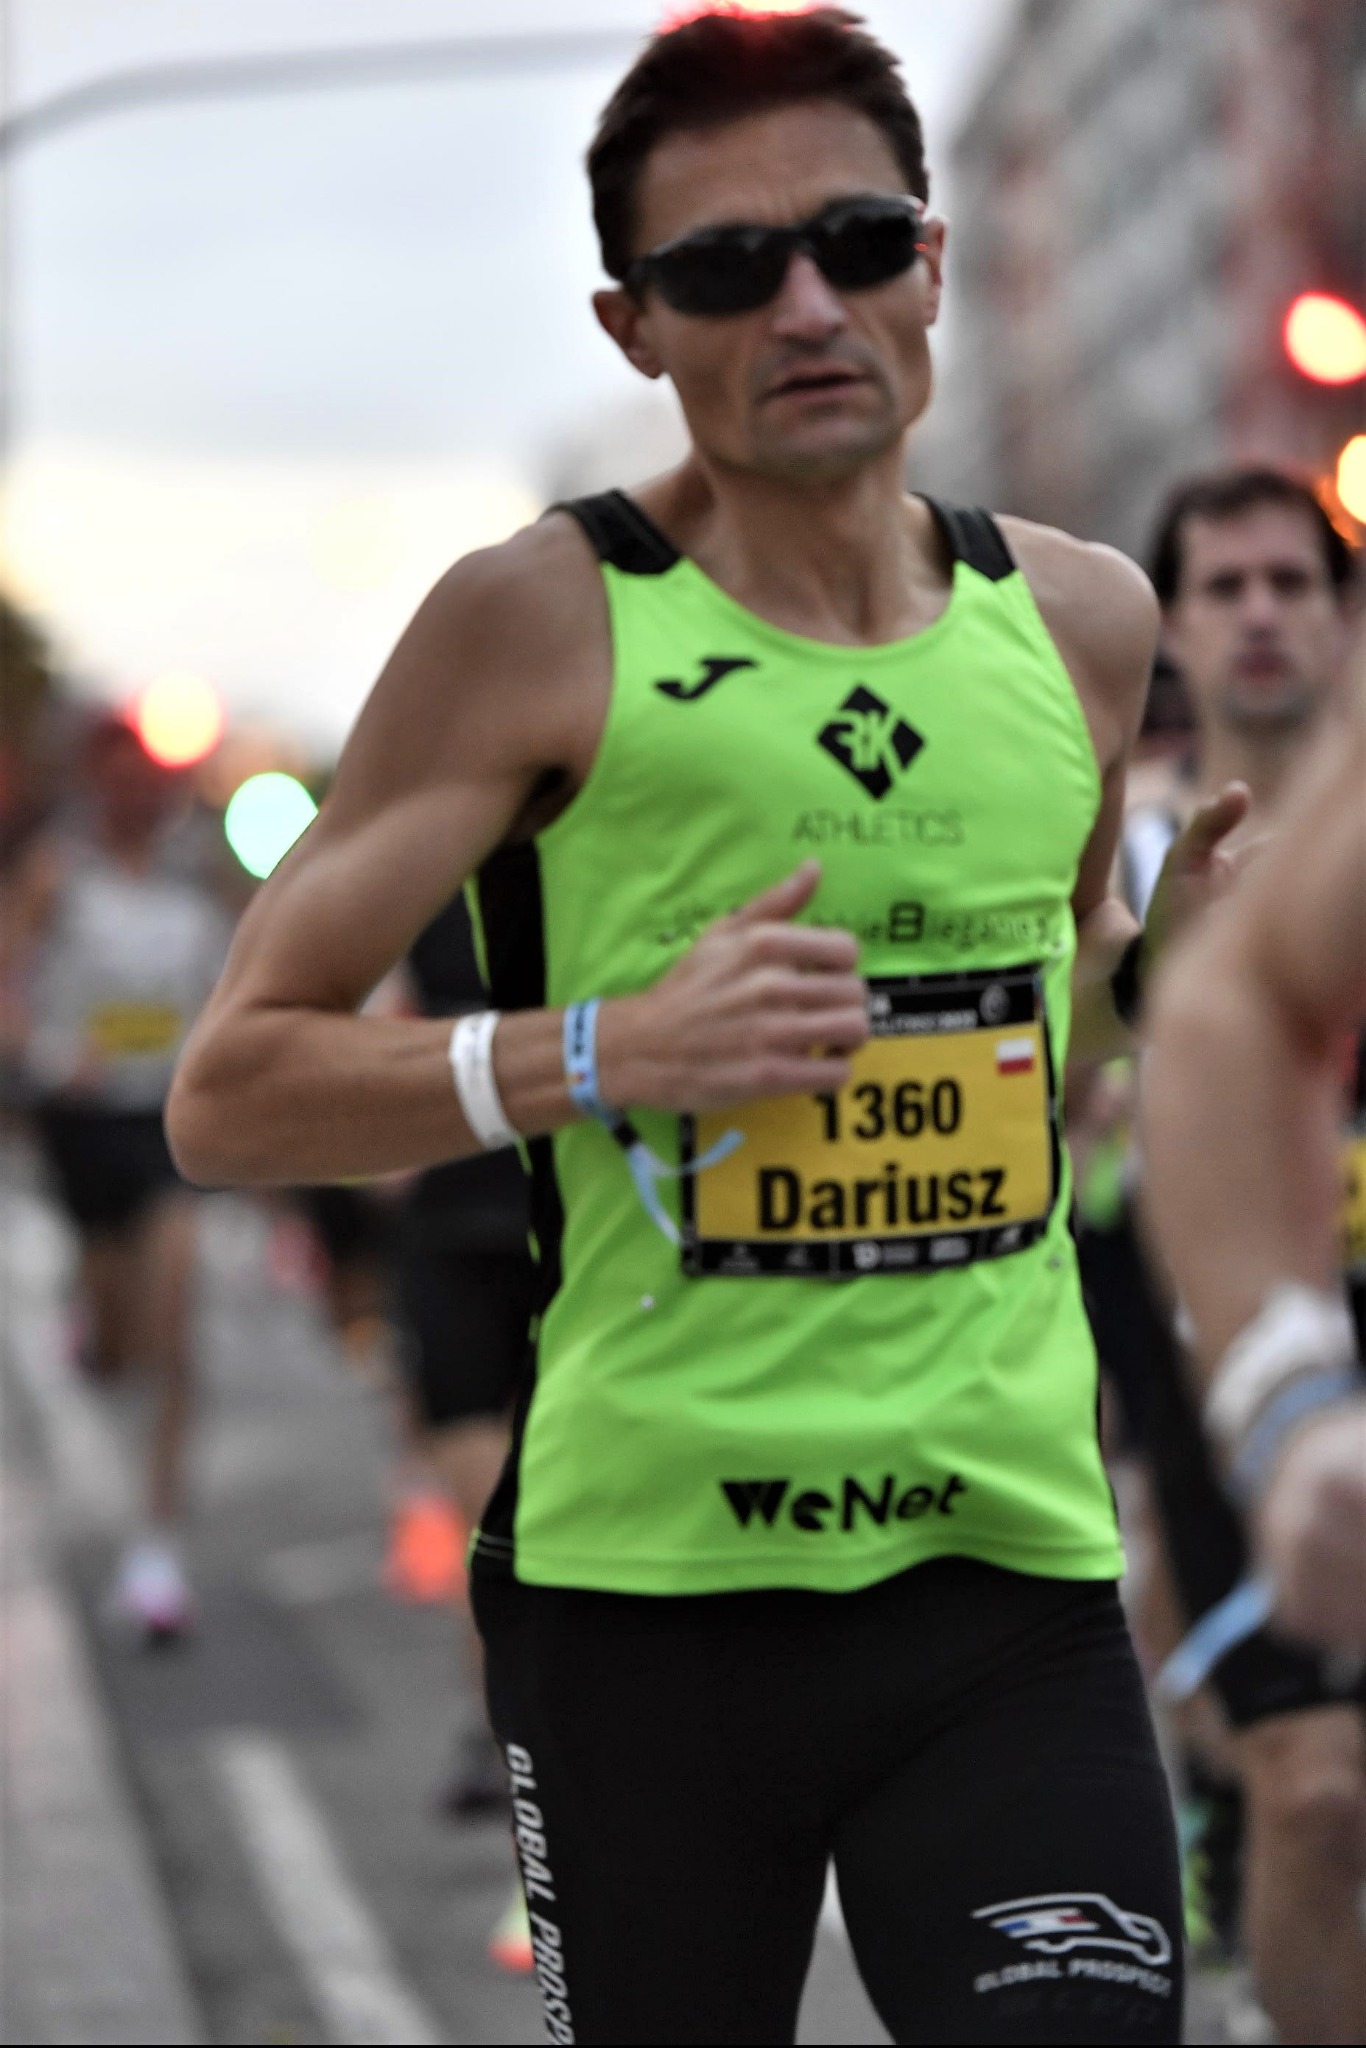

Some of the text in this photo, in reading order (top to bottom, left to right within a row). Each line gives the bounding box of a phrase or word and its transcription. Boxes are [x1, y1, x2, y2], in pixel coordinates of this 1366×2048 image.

[791, 809, 966, 848] ATHLETICS
[815, 1076, 963, 1143] 1360
[757, 1162, 1008, 1232] Dariusz
[719, 1472, 968, 1532] WeNet
[506, 1742, 557, 1902] GLOBAL
